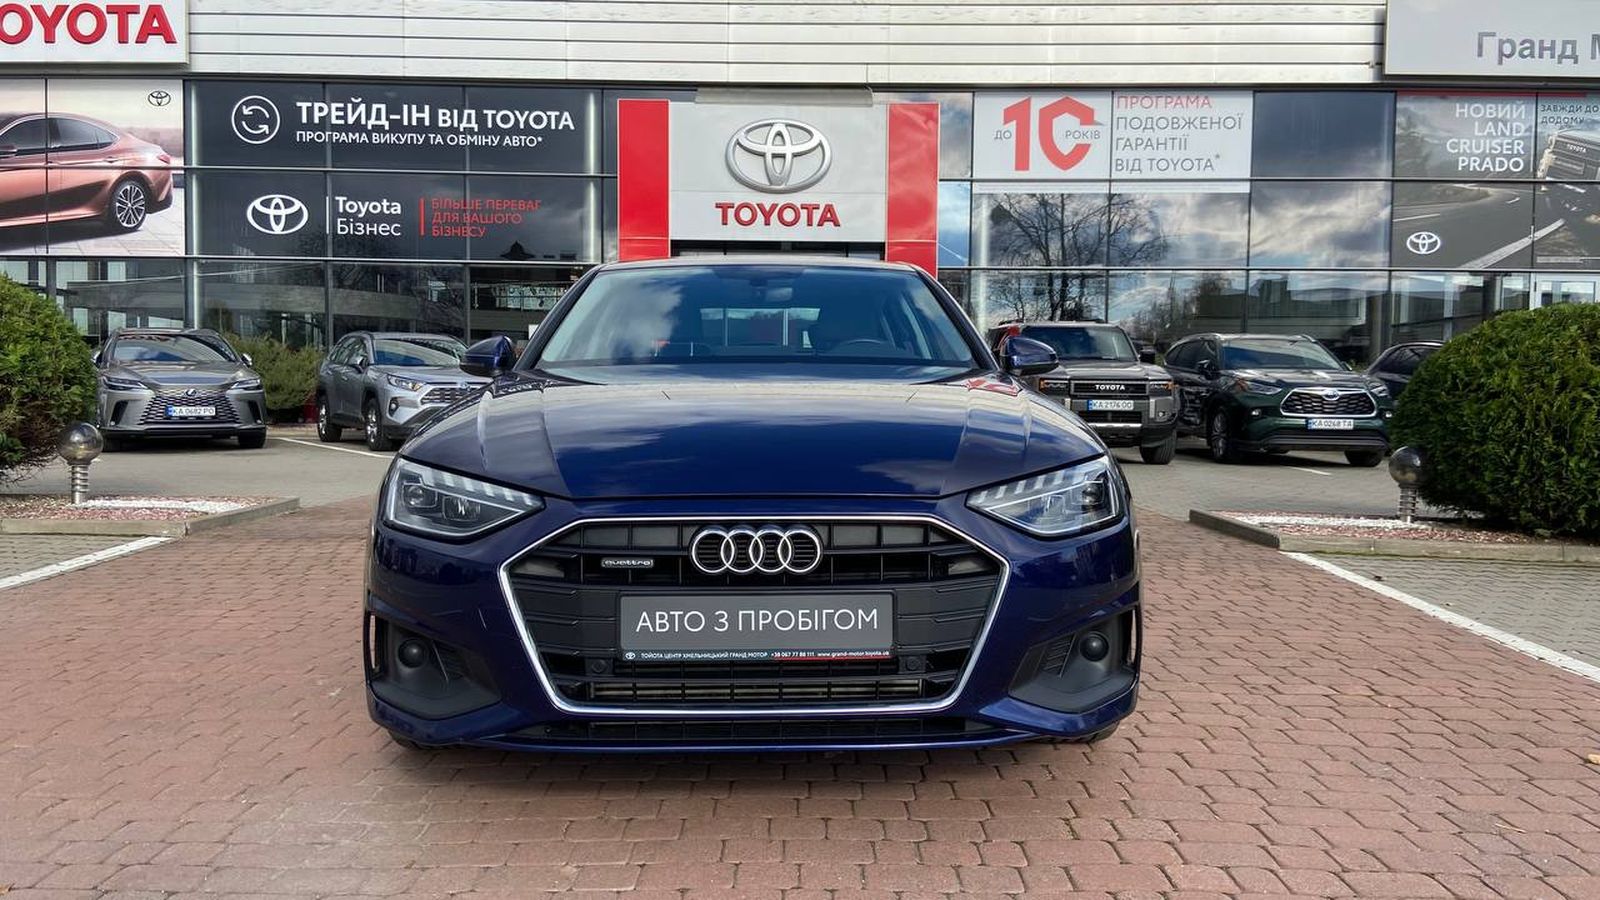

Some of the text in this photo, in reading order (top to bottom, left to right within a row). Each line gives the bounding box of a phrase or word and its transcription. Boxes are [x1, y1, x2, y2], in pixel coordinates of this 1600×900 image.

[1477, 32, 1578, 65] Гранд
[1116, 95, 1212, 110] ПРОГРАМА
[1456, 101, 1526, 119] НОВИЙ
[1541, 104, 1582, 113] ЗАВЖДИ
[296, 97, 575, 131] ТРЕЙД-ІН ВІД TOYOTA
[1541, 116, 1584, 125] ДОДОМУ
[1116, 113, 1243, 131] ПОДОВЖЕНОЇ
[1475, 121, 1525, 136] LAND
[296, 131, 369, 144] ПРОГРАМА
[372, 132, 425, 146] ВИКУПУ
[428, 133, 444, 145] ТА
[447, 135, 500, 147] ОБМІНУ
[994, 130, 1012, 140] ДО
[1065, 130, 1101, 140] РОКІВ
[1115, 134, 1188, 151] ГАРАНТІЇ
[1447, 139, 1525, 154] CRUISER
[1115, 158, 1142, 173] ВІД
[1458, 157, 1524, 172] PRADO
[335, 196, 401, 218] Toyota
[431, 198, 542, 211] БІЛЬШЕ ПЕРЕВАГ
[432, 212, 522, 225] ДЛЯ ВАШОГО
[715, 202, 841, 227] TOYOTA
[337, 218, 401, 236] Бізнес
[432, 225, 486, 237] БІЗНЕСУ
[604, 559, 651, 568] quattro
[636, 608, 878, 632] АВТО З ПРОБІГОМ
